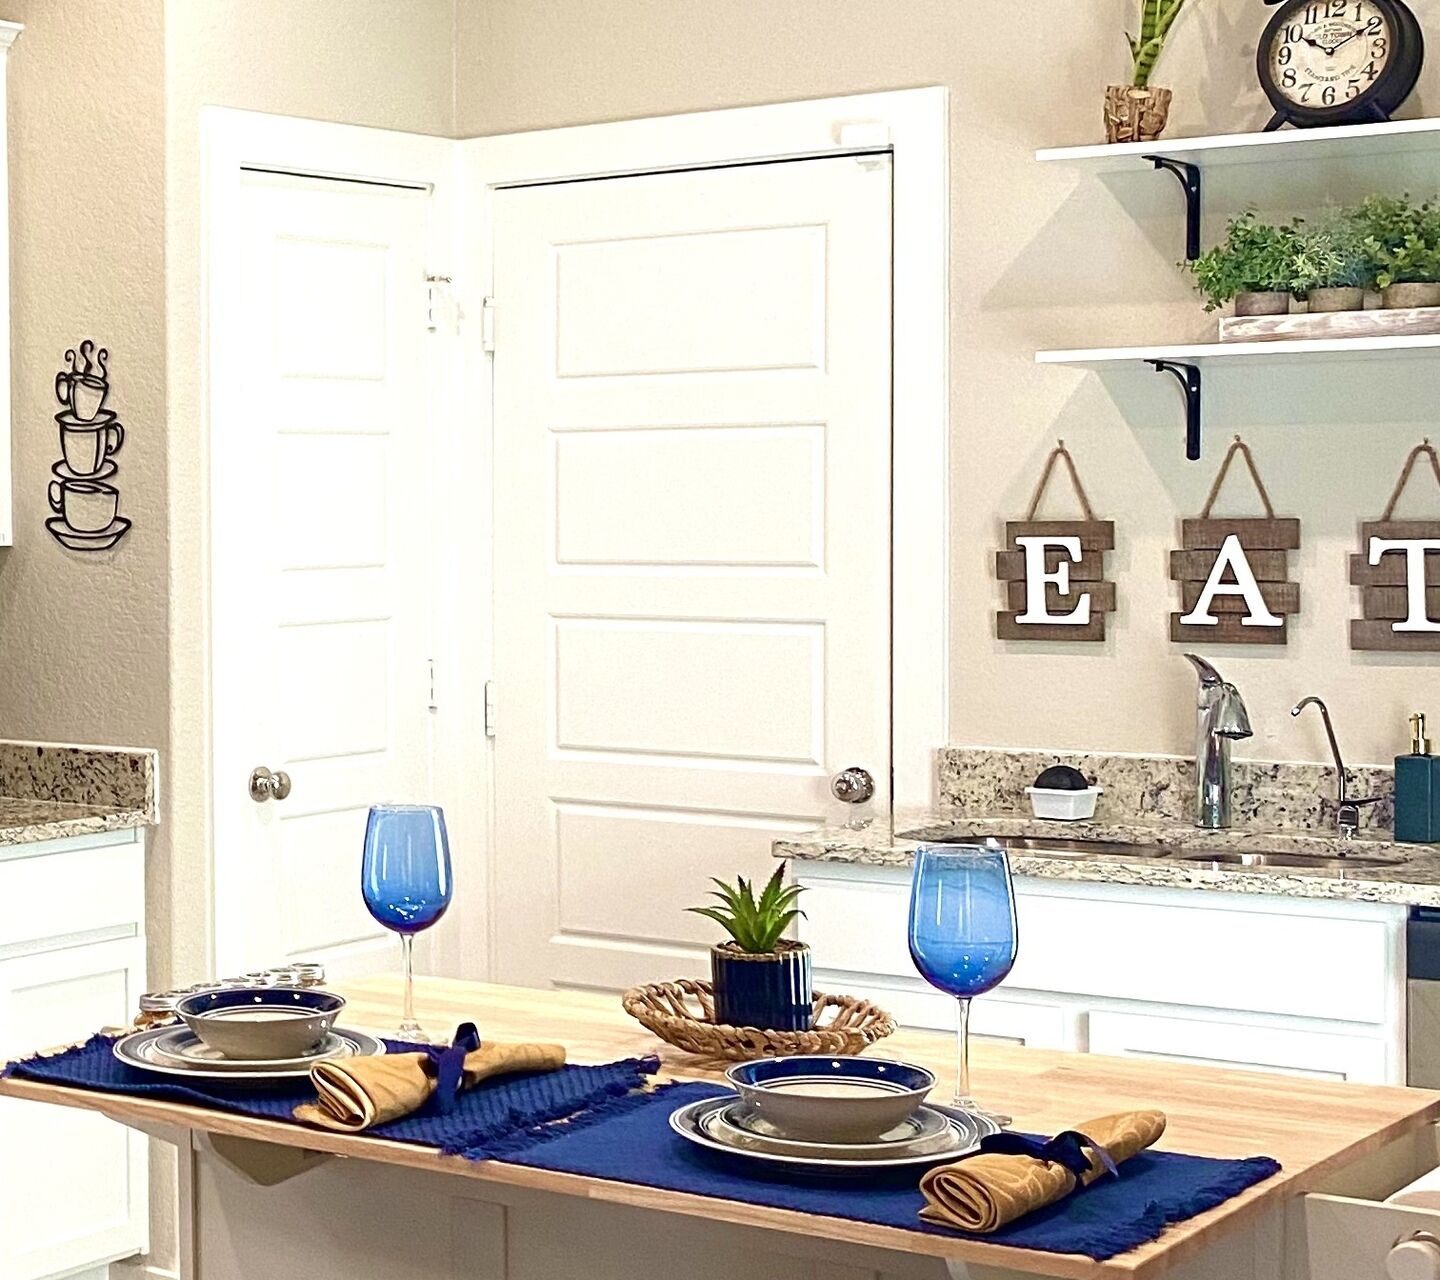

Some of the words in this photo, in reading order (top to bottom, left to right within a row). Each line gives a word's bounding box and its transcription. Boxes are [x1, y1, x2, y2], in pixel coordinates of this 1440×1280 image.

[1305, 5, 1318, 25] 11
[1323, 0, 1347, 18] 12
[1355, 2, 1363, 22] 1
[1281, 24, 1303, 44] 10
[1367, 16, 1383, 36] 2
[1278, 46, 1292, 66] 9
[1371, 38, 1387, 59] 3
[1282, 68, 1296, 88] 8
[1361, 61, 1379, 81] 4
[1298, 83, 1316, 103] 7
[1321, 86, 1336, 106] 6
[1345, 79, 1360, 99] 5
